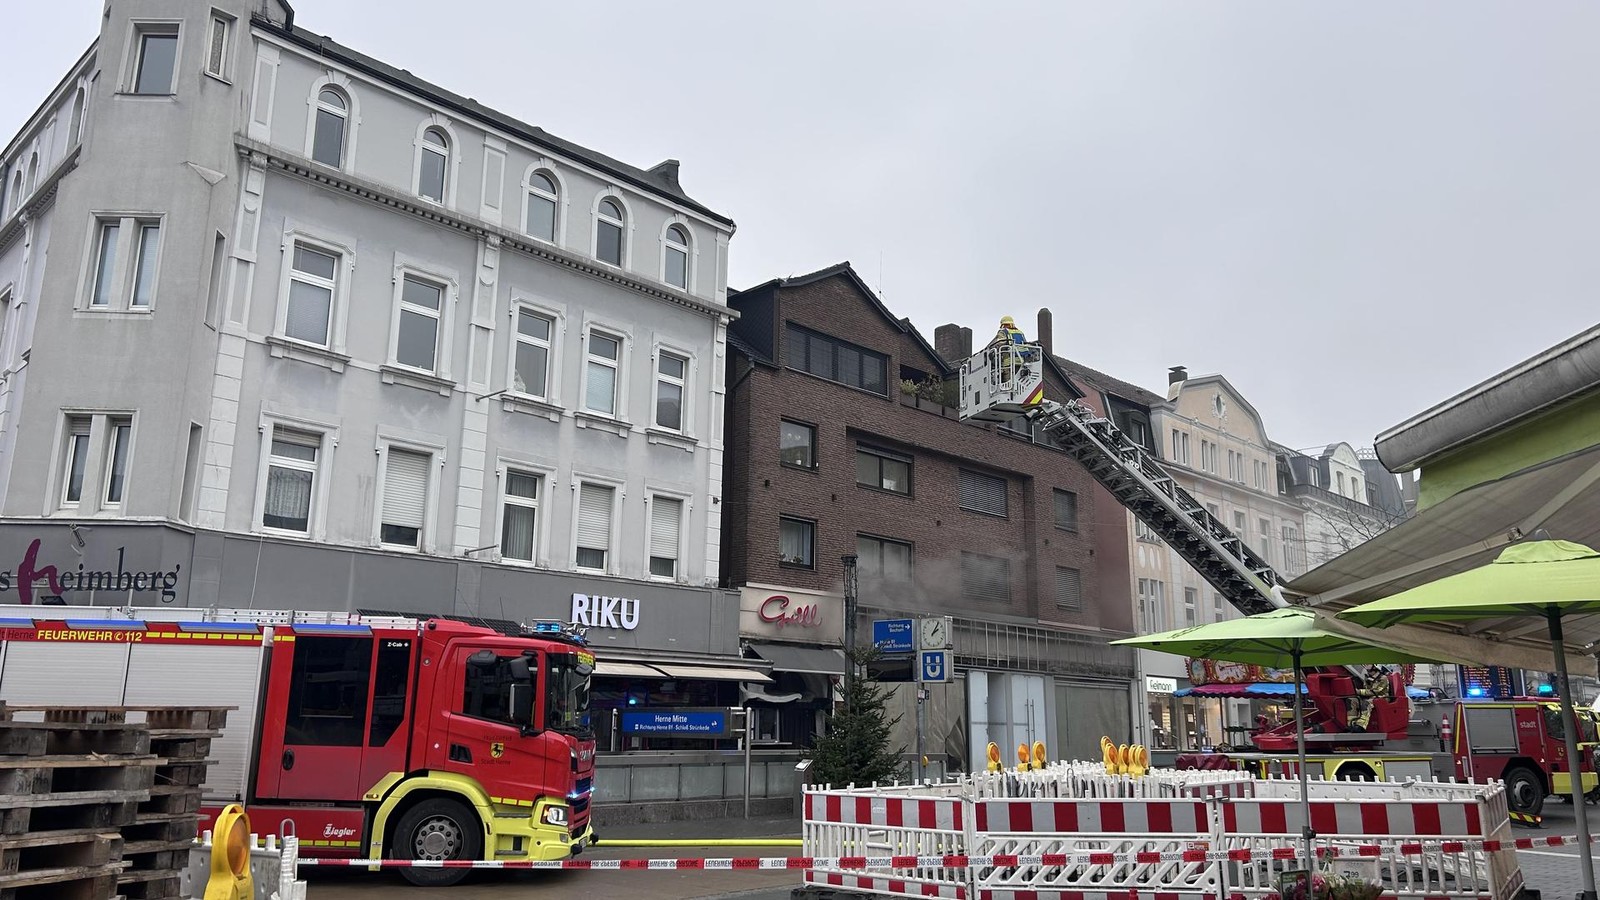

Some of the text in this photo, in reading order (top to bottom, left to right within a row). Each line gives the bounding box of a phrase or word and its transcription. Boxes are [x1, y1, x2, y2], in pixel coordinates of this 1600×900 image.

[17, 538, 181, 605] heimberg
[572, 592, 640, 630] RIKU
[37, 629, 143, 642] FEUERWEHR 112
[654, 714, 688, 723] Herne Mitte
[323, 823, 356, 838] Ziegler
